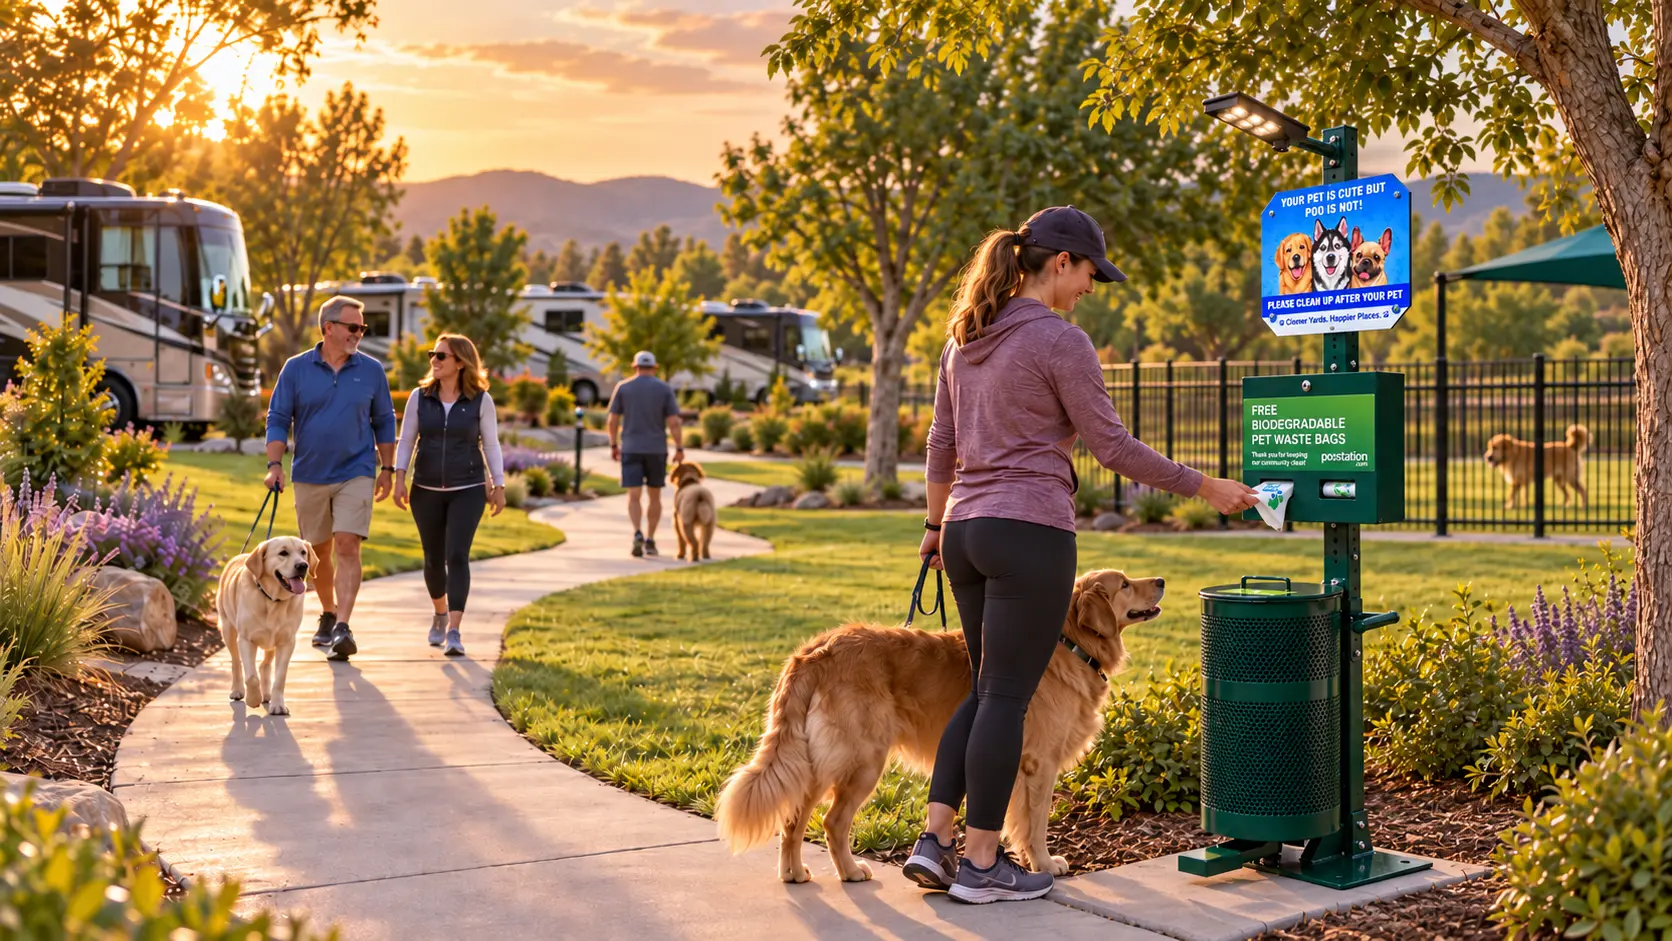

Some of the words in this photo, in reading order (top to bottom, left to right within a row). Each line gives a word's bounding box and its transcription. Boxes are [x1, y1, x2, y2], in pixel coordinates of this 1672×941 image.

[1281, 195, 1304, 207] YOUR
[1307, 192, 1325, 204] PET
[1327, 189, 1336, 201] IS
[1338, 186, 1363, 199] CUTE
[1366, 182, 1386, 195] BUT
[1305, 206, 1325, 217] POO
[1327, 204, 1336, 215] IS
[1339, 200, 1363, 212] NOT!
[1268, 299, 1295, 310] PLEASE
[1296, 297, 1321, 308] CLEAN
[1323, 295, 1334, 305] UP
[1335, 293, 1360, 304] AFTER
[1362, 291, 1385, 303] YOUR
[1387, 289, 1403, 300] PET
[1330, 313, 1356, 324] Happier
[1357, 311, 1382, 321] Places.
[1251, 404, 1278, 416] FREE
[1251, 417, 1346, 430] BIODEGRADABLE
[1251, 434, 1272, 445] PET
[1274, 433, 1312, 445] WASTE
[1315, 433, 1346, 445] BAGS
